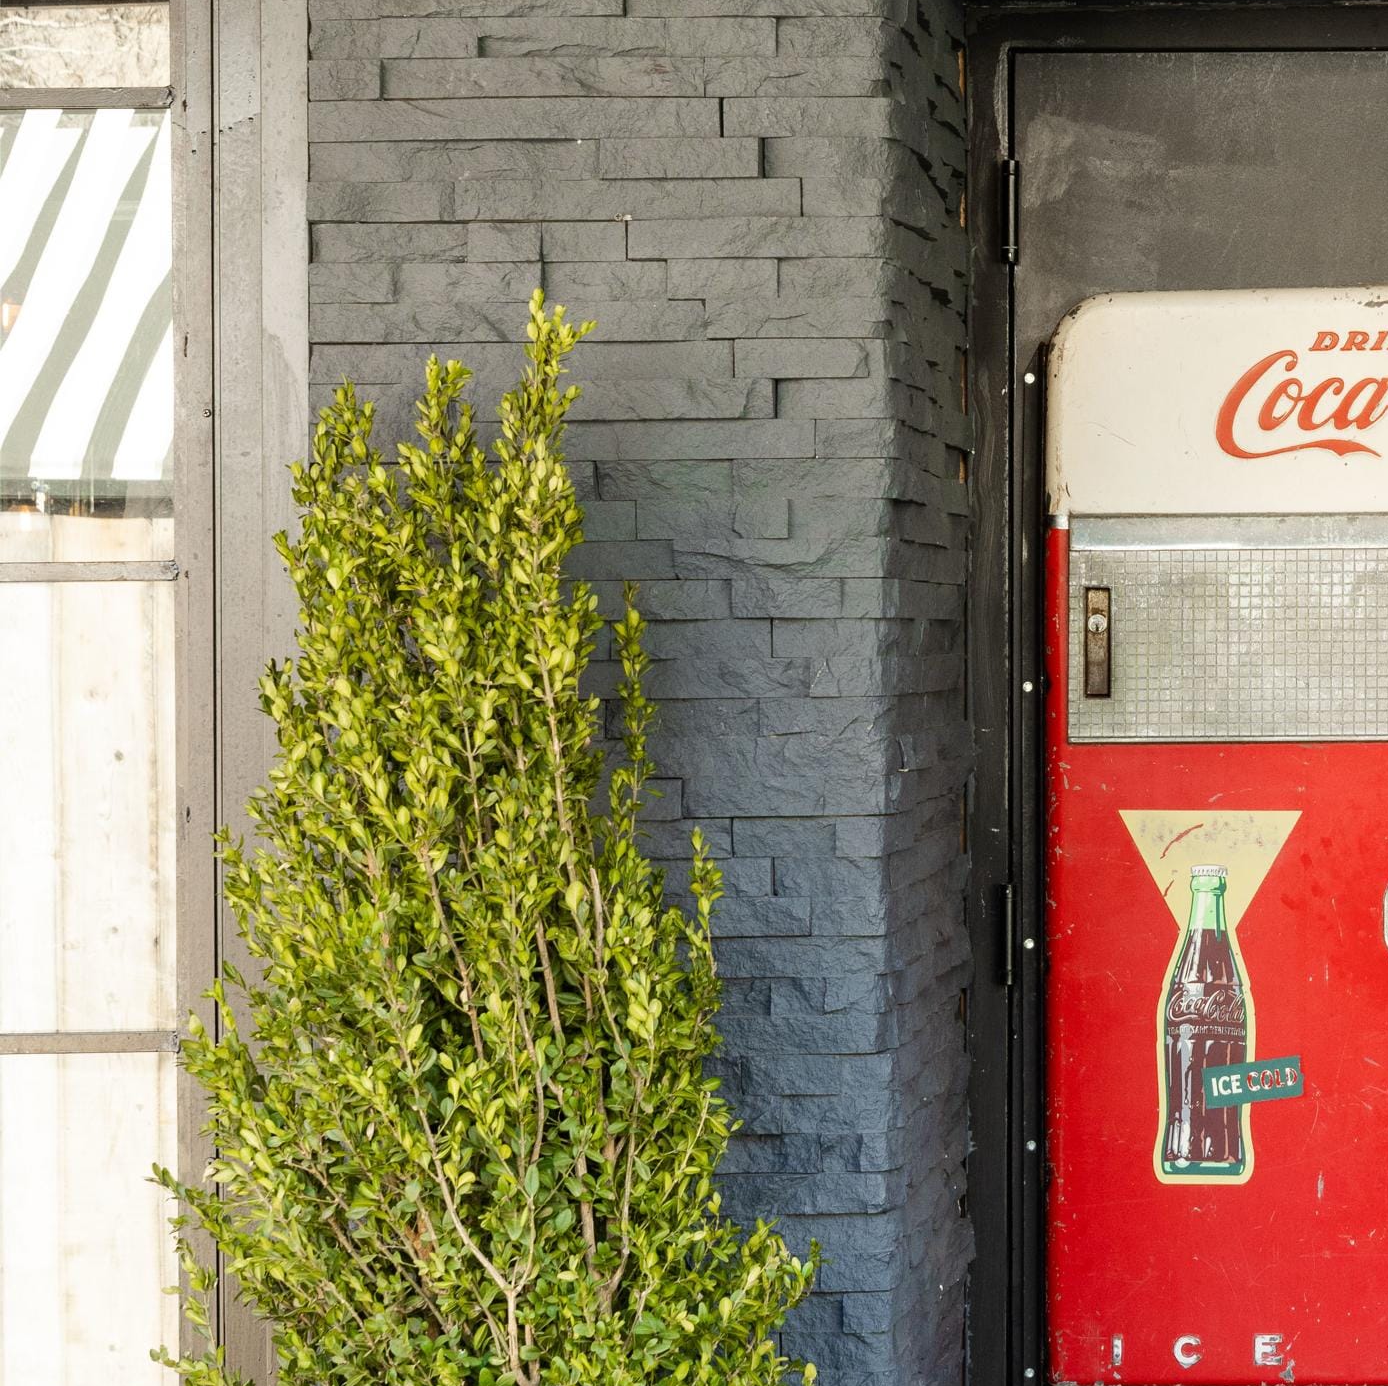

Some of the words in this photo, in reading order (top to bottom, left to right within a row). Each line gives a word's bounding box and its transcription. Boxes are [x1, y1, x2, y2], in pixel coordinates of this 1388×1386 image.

[1211, 1074, 1242, 1097] ICE
[1246, 1067, 1298, 1091] COLD
[1112, 1334, 1284, 1368] ICE
